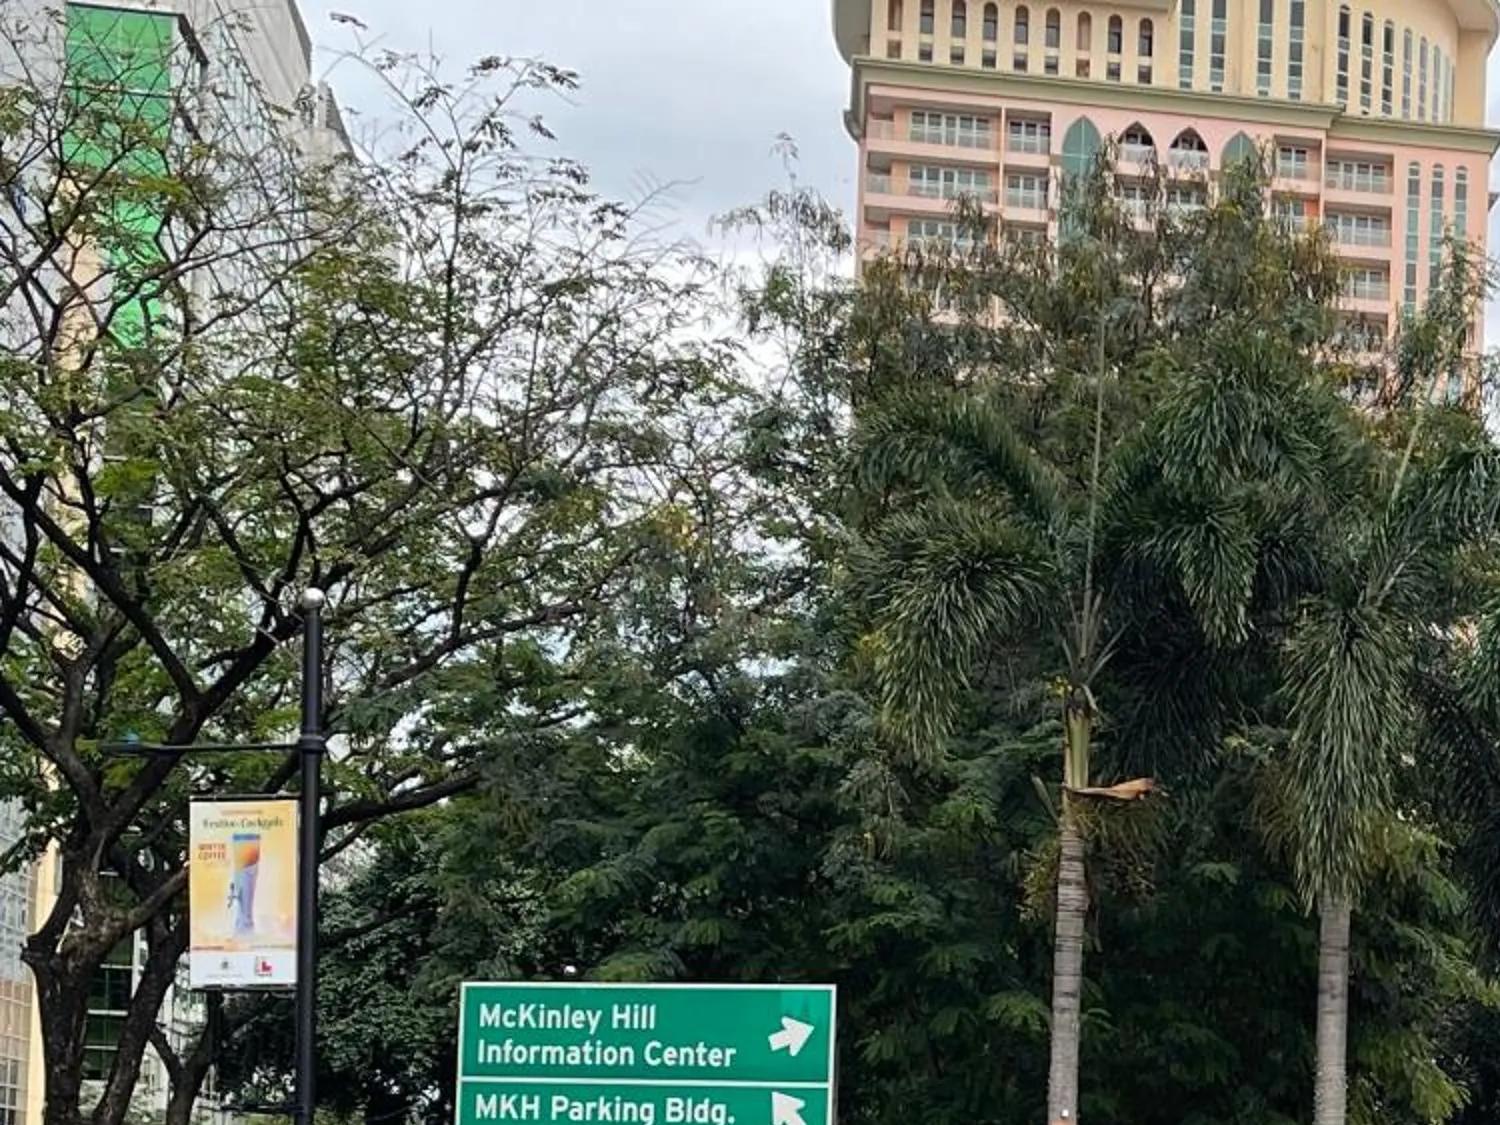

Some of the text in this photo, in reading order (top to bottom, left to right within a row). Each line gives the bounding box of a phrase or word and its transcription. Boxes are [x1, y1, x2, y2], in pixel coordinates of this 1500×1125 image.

[479, 1003, 656, 1034] McKinley Hill
[477, 1039, 737, 1068] Information Center
[475, 1094, 540, 1121] MKH
